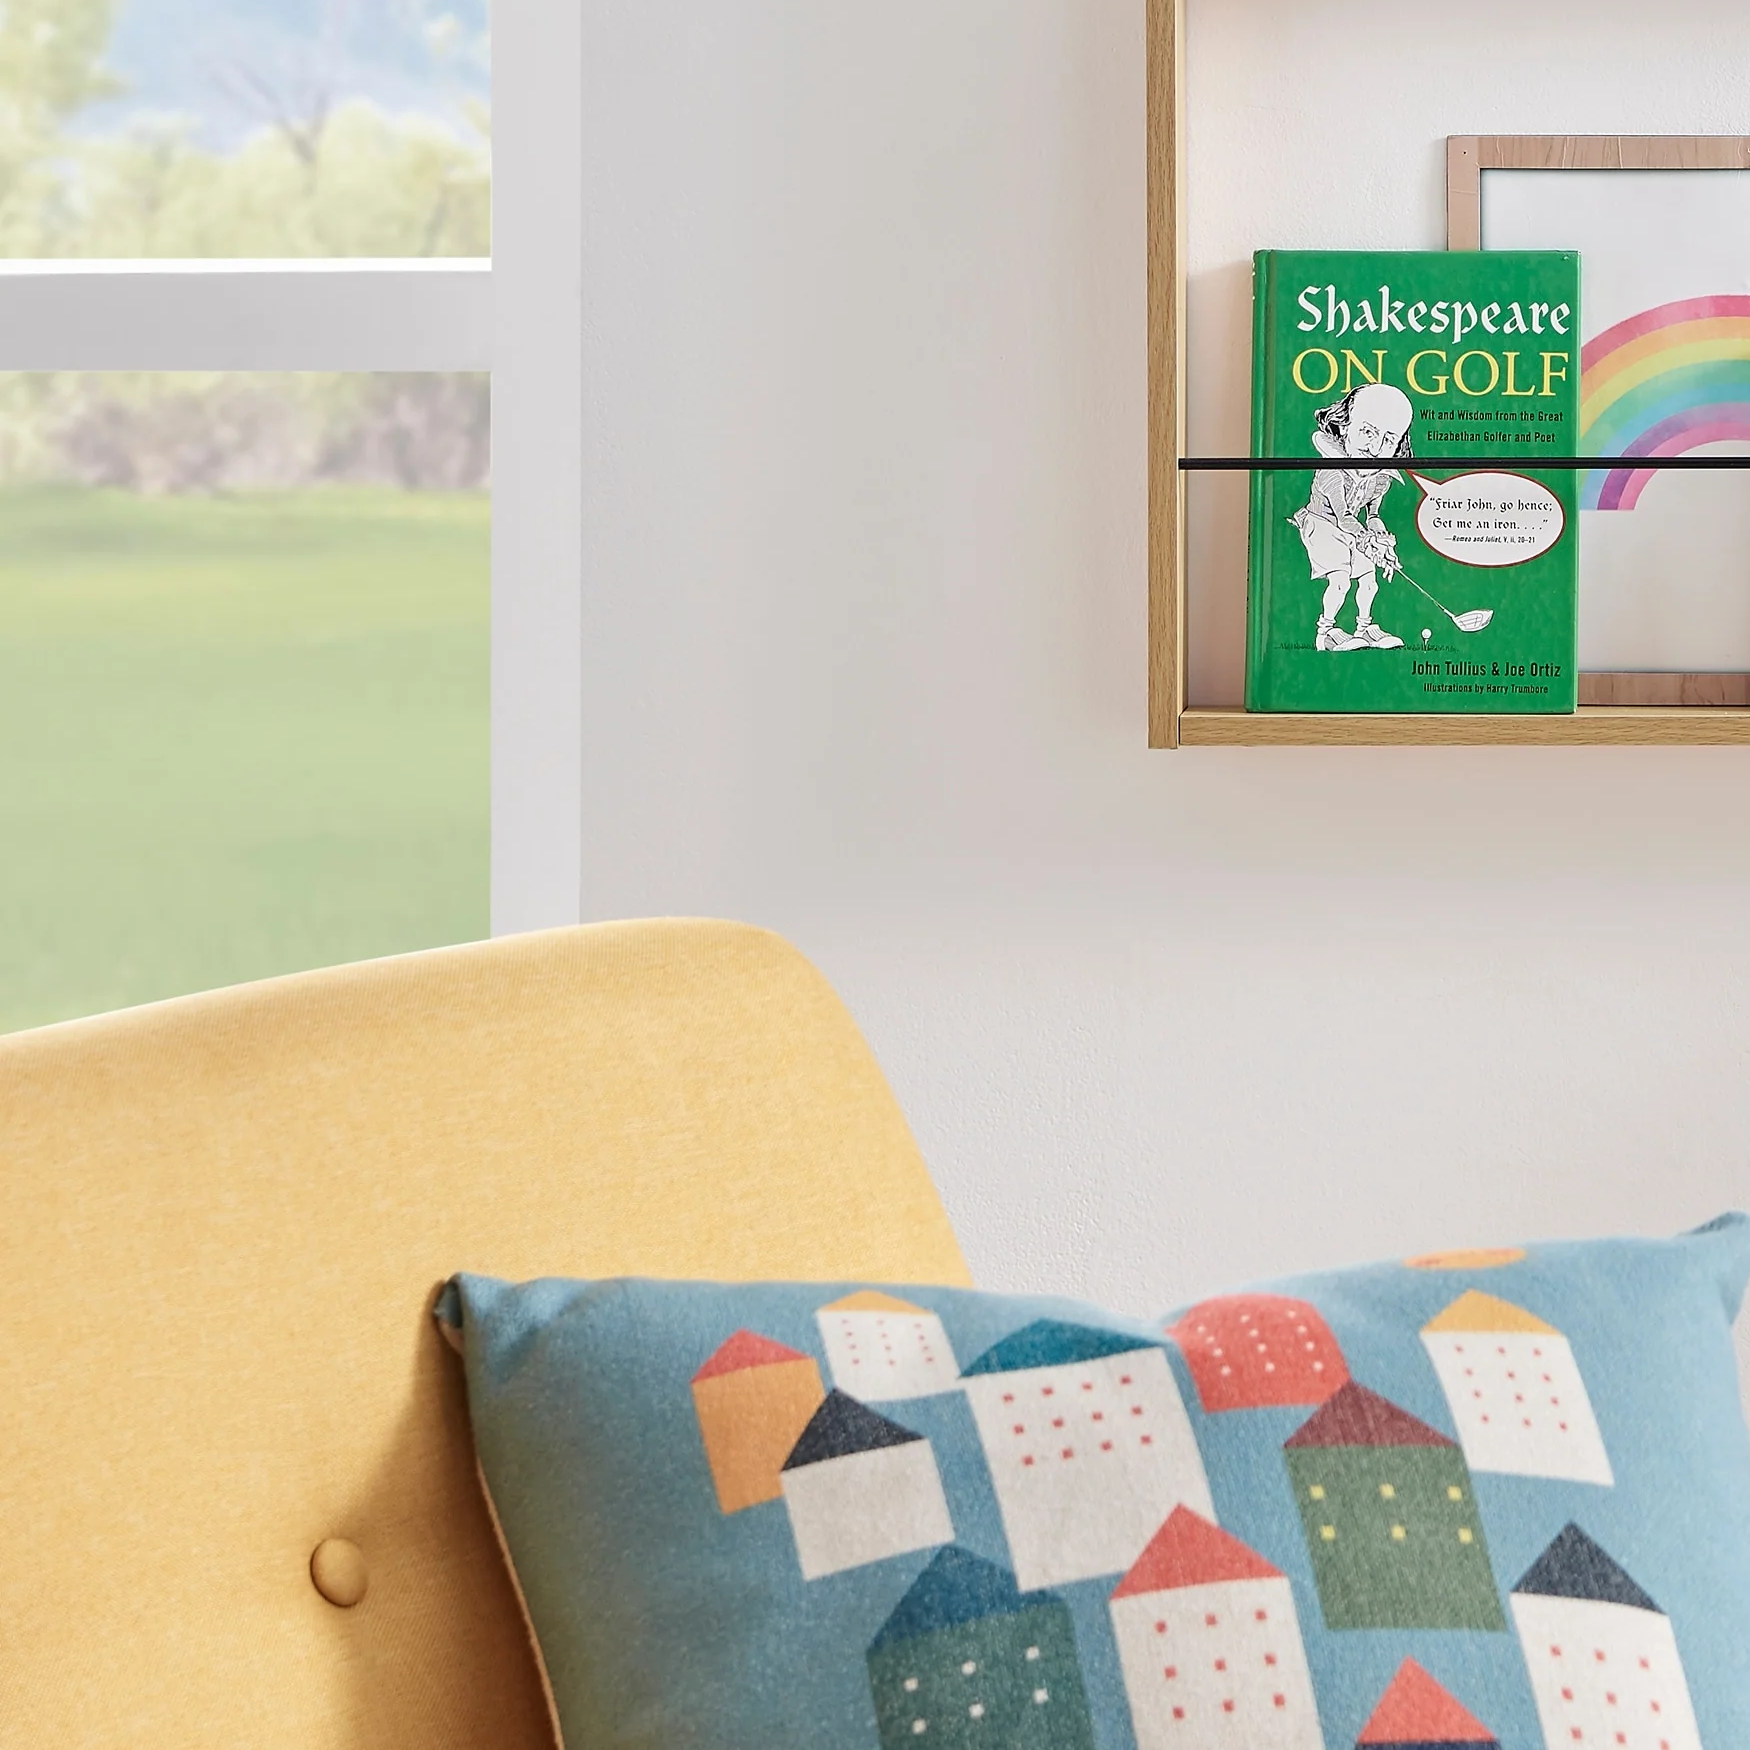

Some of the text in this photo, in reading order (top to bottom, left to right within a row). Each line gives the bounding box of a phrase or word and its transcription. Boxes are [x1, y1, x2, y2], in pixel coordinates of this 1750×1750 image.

[1296, 284, 1571, 345] Shakespeare
[1292, 347, 1570, 397] ON GOLF
[1420, 409, 1563, 422] Wit and Wisdom from the Great
[1427, 431, 1556, 443] Elizabethan Golfer and Poet
[1466, 498, 1496, 512] John,
[1499, 501, 1514, 513] go
[1517, 499, 1553, 512] hence;
[1432, 517, 1453, 529] Get
[1456, 520, 1472, 529] me
[1476, 520, 1490, 529] an
[1411, 660, 1562, 678] John Tullius & Joe Ortiz
[1423, 683, 1549, 695] Illustrations by Harry Trumbore
